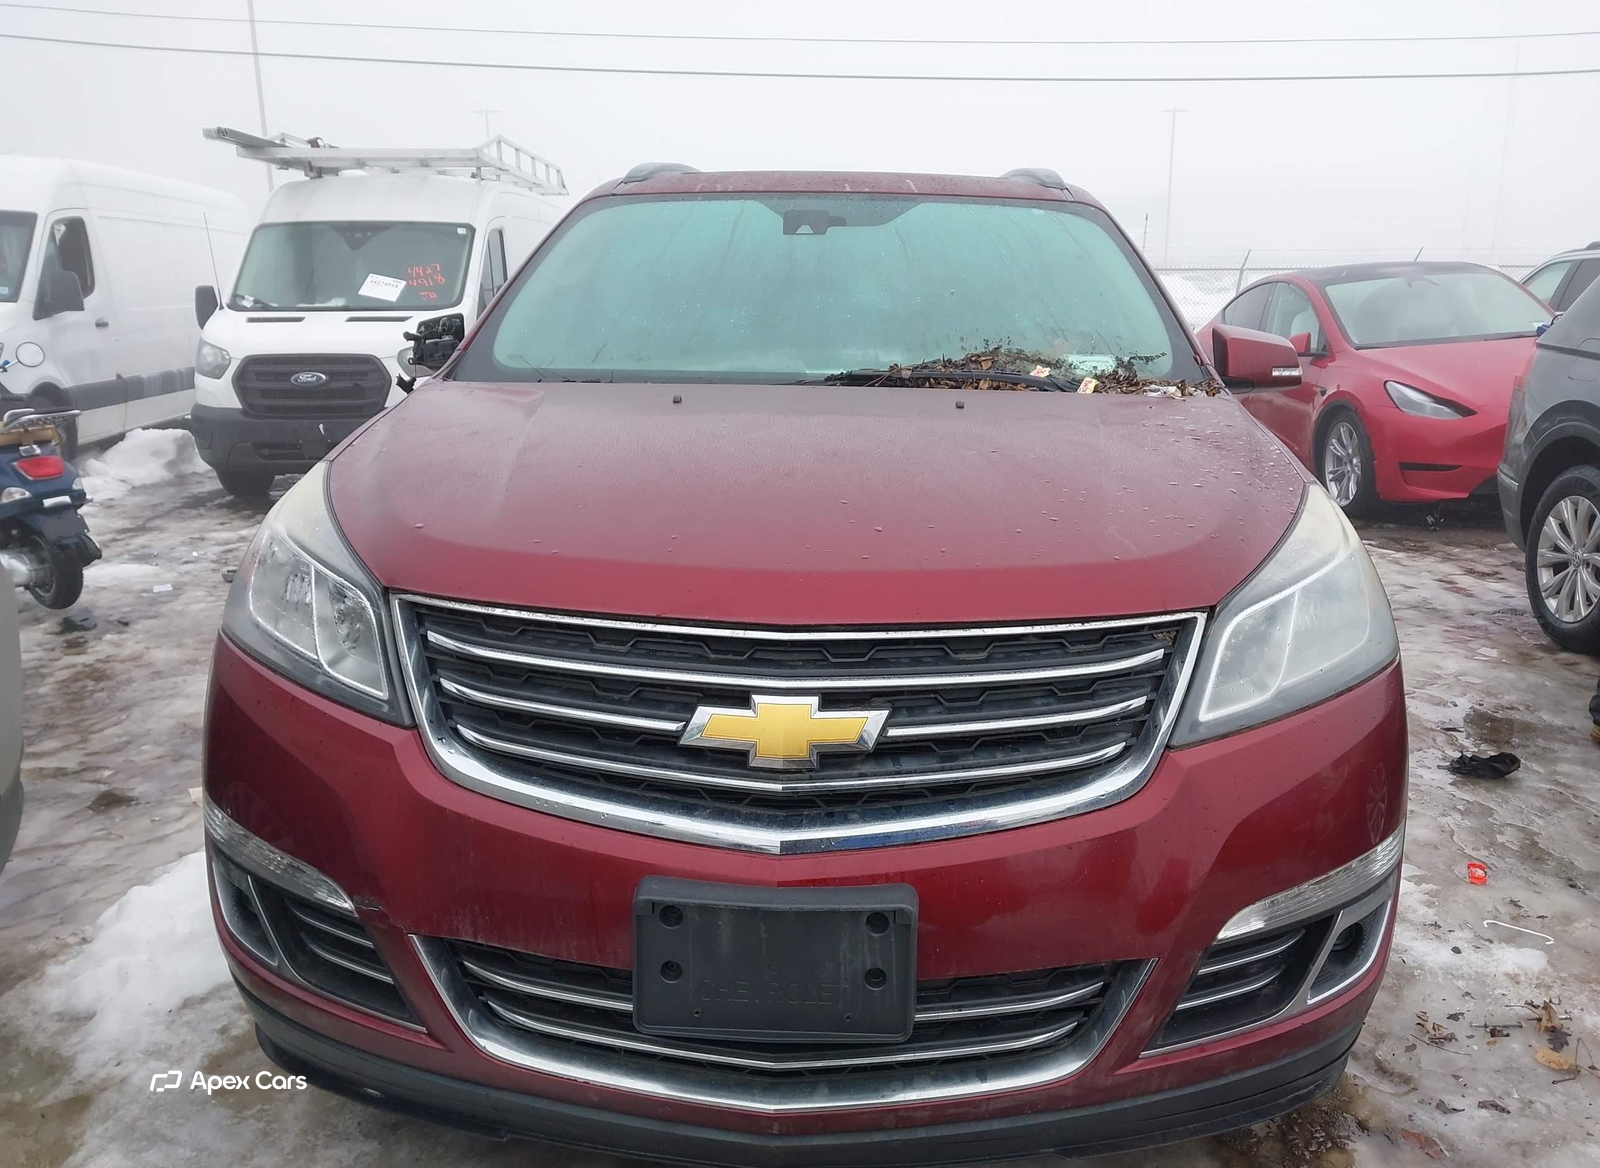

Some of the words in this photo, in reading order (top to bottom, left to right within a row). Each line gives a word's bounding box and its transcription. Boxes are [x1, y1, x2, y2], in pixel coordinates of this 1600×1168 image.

[407, 263, 440, 277] 4427
[408, 273, 445, 286] 4918
[700, 978, 849, 1004] CHEVROLET
